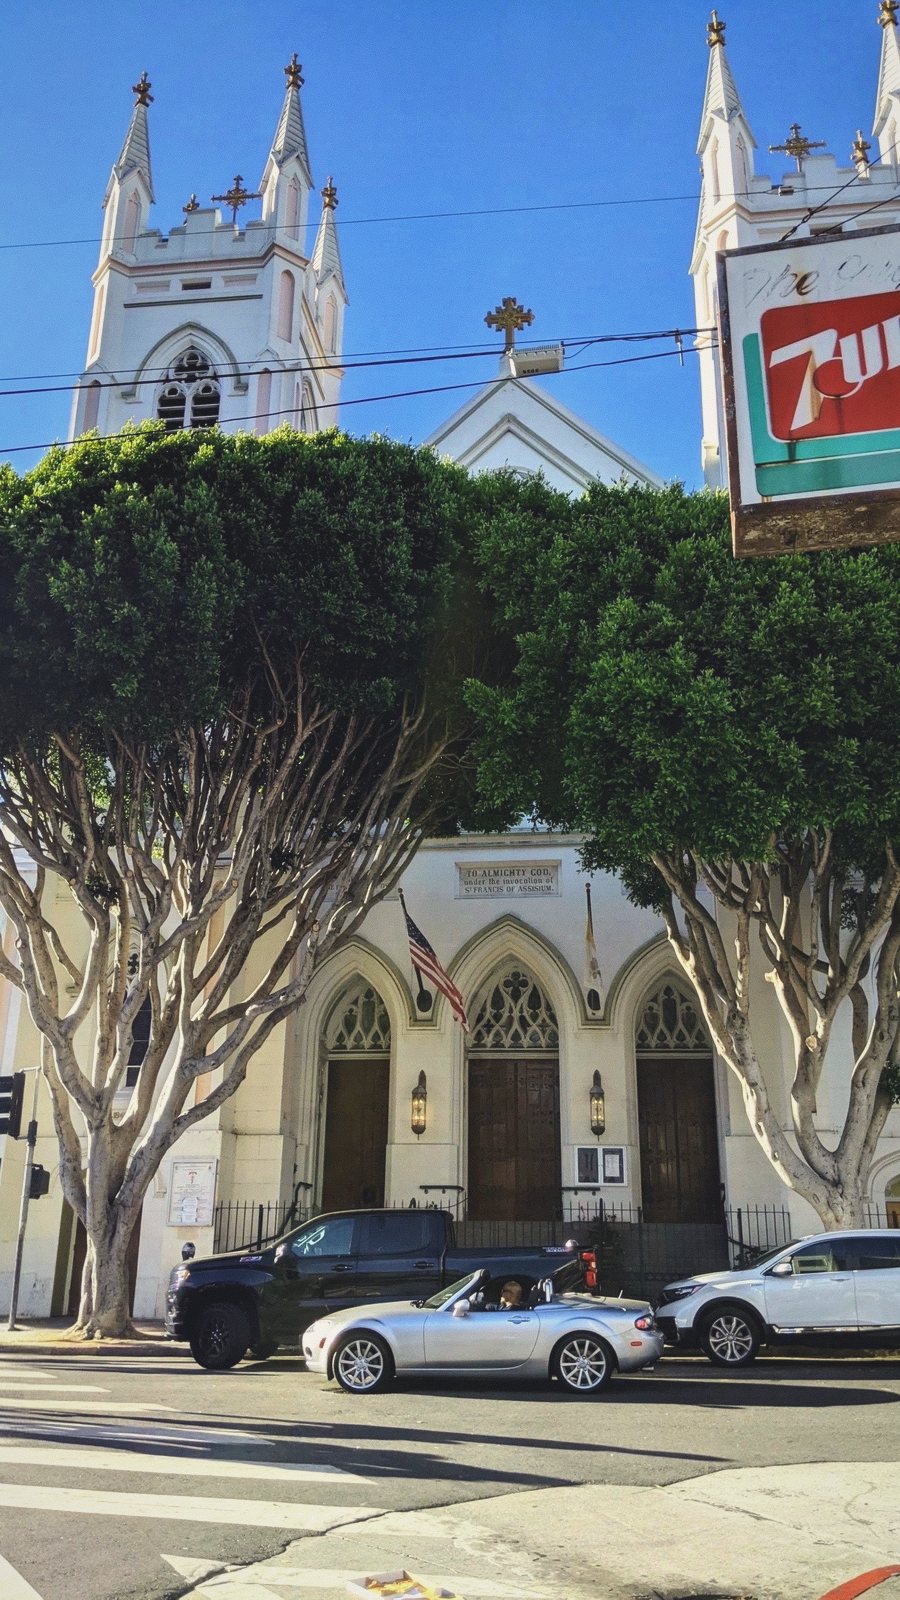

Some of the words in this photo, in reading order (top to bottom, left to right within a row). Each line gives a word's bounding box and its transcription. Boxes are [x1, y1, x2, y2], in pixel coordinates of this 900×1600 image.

[465, 870, 478, 878] TO
[481, 868, 527, 877] ALMIGHTY
[489, 877, 500, 885] the
[502, 877, 543, 885] invocation
